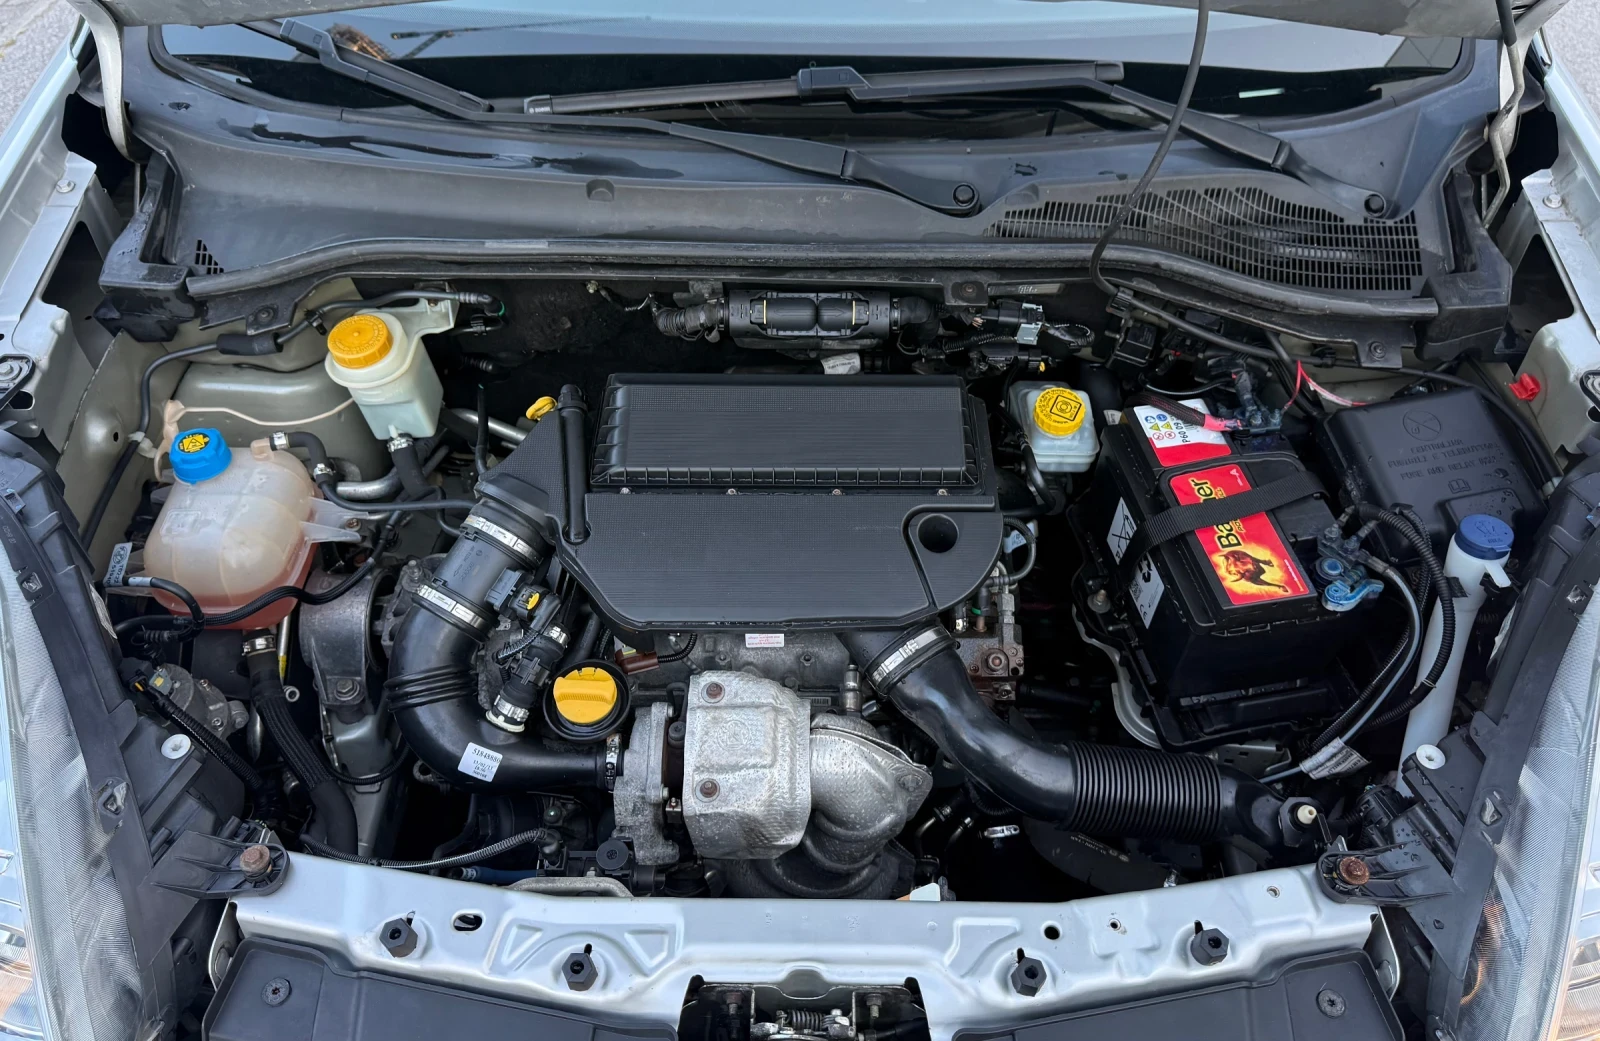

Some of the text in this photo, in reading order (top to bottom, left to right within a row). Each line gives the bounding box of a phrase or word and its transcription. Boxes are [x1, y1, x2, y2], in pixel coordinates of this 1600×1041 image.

[1178, 430, 1191, 443] P60
[1400, 469, 1424, 480] FUSE
[1188, 477, 1243, 550] Baer
